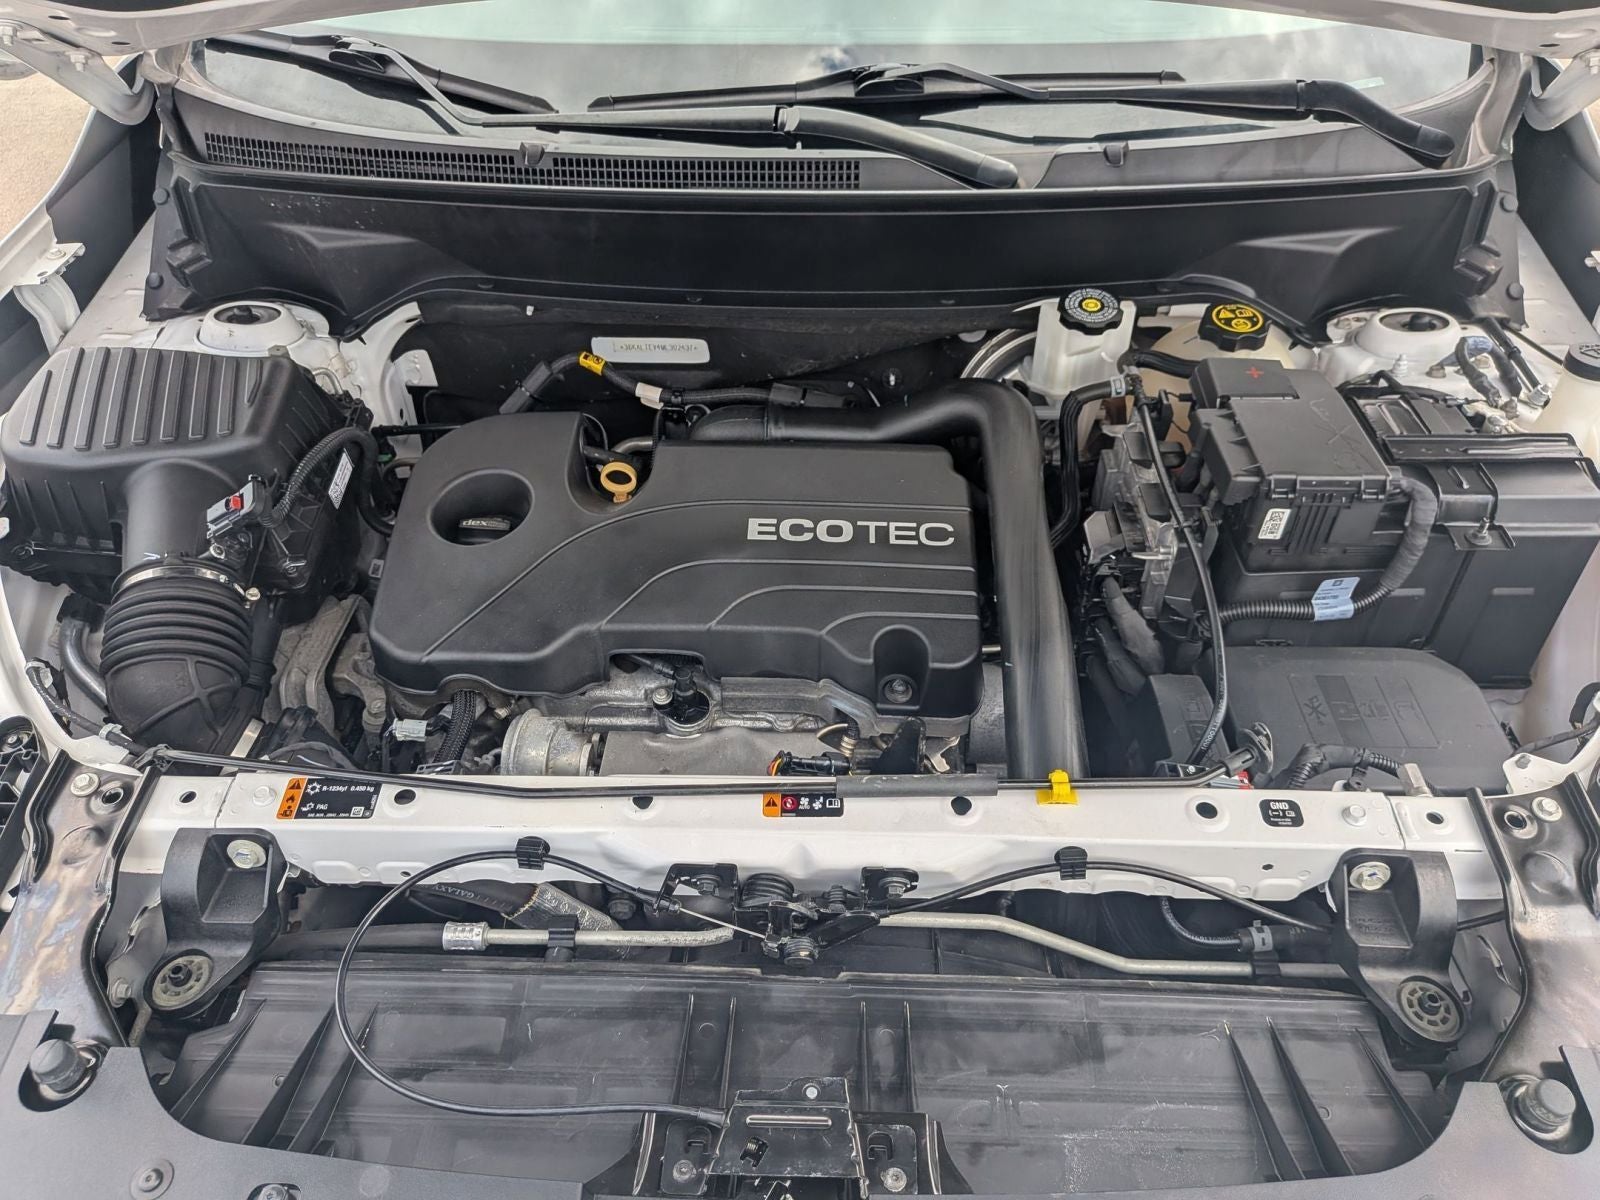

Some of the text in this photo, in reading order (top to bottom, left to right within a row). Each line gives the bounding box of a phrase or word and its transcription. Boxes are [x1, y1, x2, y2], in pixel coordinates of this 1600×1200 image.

[747, 518, 955, 546] ECOTEC
[366, 785, 374, 793] kg
[1270, 801, 1289, 810] GND
[432, 883, 475, 899] GALAXY
